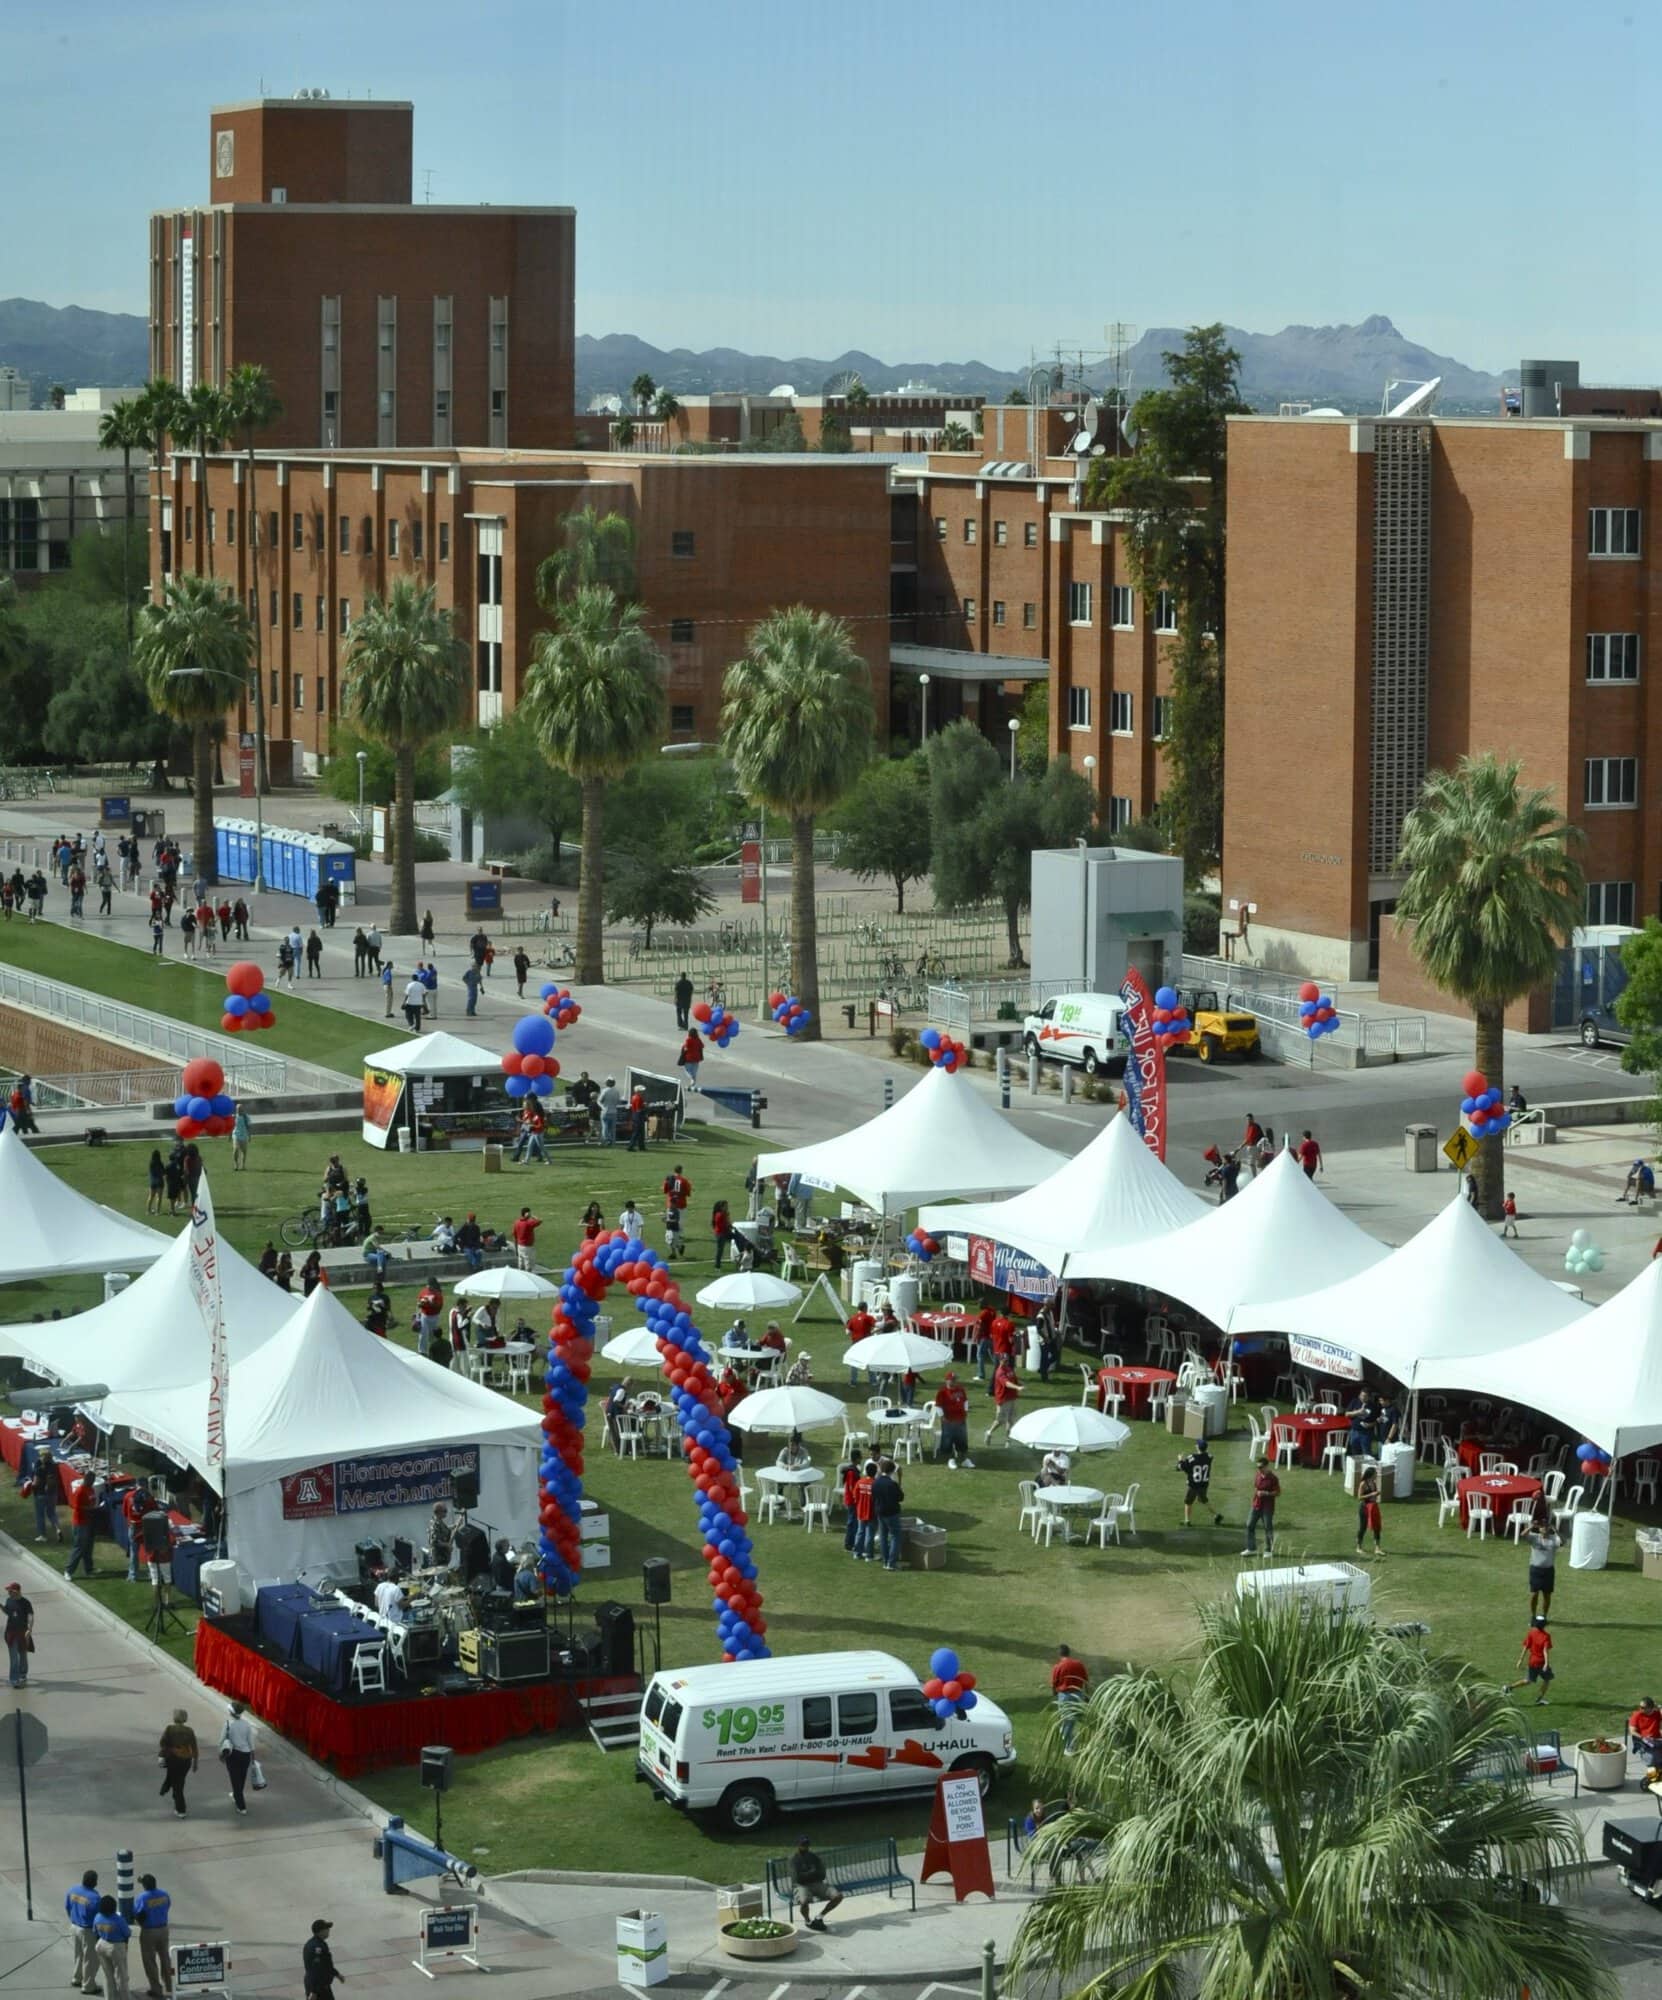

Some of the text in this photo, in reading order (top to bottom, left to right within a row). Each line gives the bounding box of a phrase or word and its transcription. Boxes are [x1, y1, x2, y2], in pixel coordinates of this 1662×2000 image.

[995, 1246, 1041, 1271] Welcome
[1323, 1343, 1353, 1361] CENTRAL
[339, 1451, 477, 1484] Homecoming
[1192, 1464, 1209, 1483] 82
[340, 1477, 457, 1511] Merchandi
[716, 1749, 737, 1758] Rent
[739, 1746, 756, 1755] This
[758, 1744, 776, 1754] Van!
[780, 1743, 798, 1752] Call
[947, 1790, 977, 1799] ALCOHOL
[948, 1798, 978, 1807] ALLOWED
[951, 1806, 977, 1815] BEYOND
[956, 1821, 975, 1830] POINT
[185, 1956, 216, 1964] Access
[179, 1962, 223, 1974] Controlled
